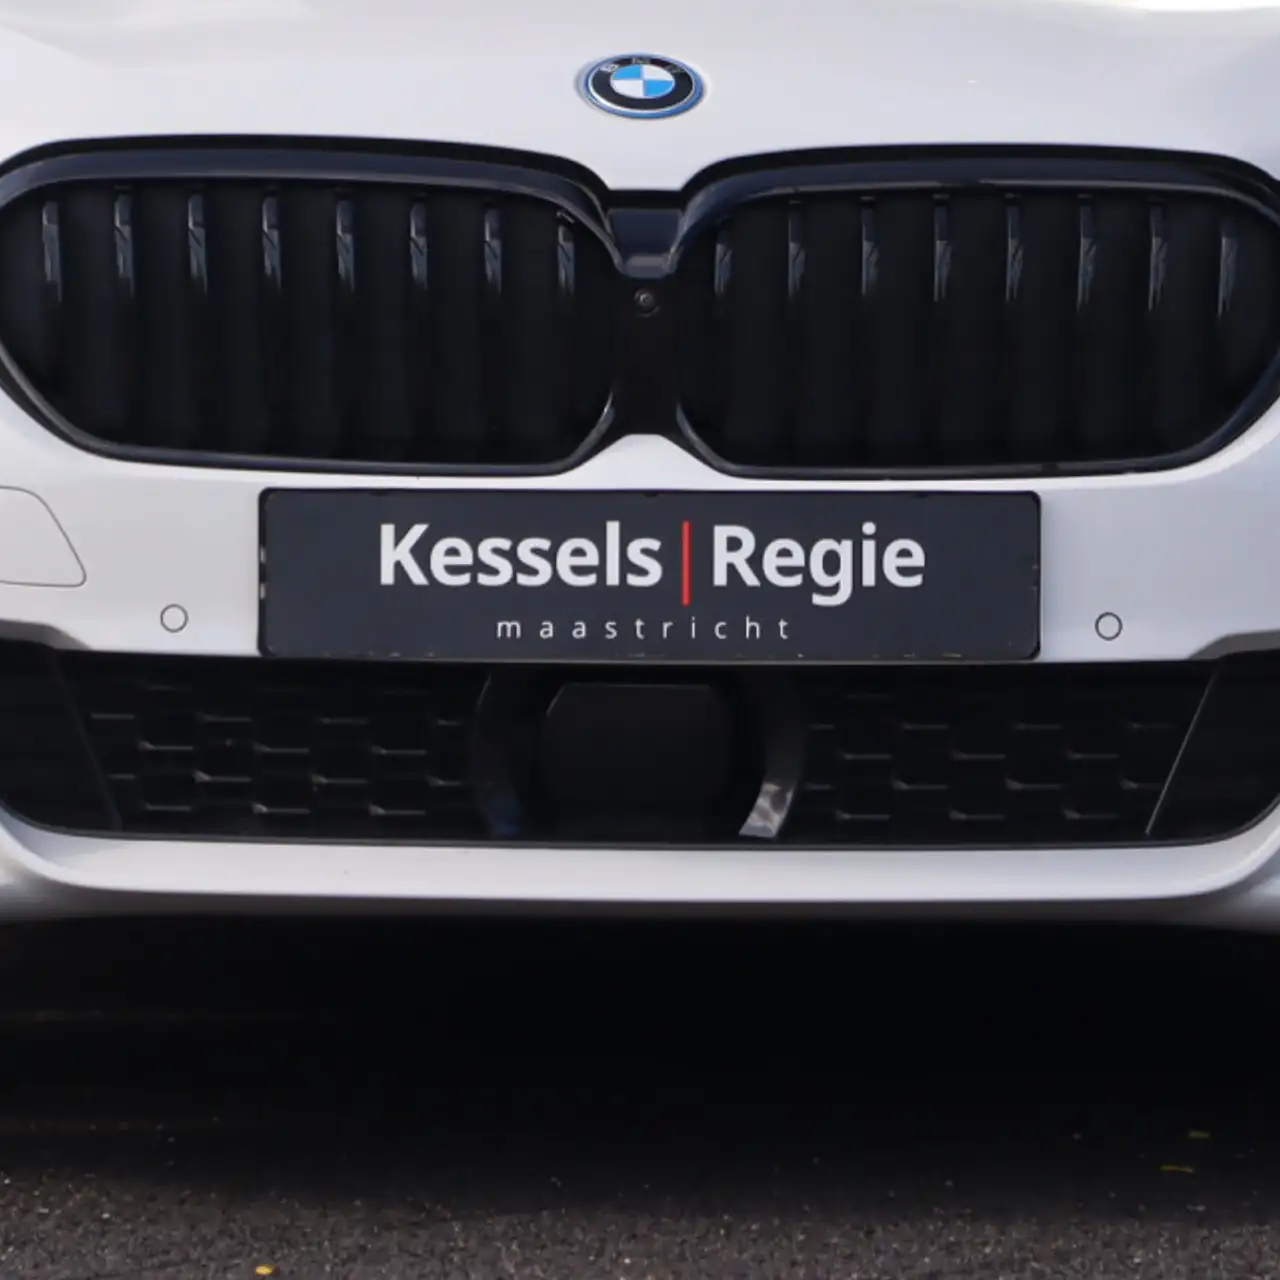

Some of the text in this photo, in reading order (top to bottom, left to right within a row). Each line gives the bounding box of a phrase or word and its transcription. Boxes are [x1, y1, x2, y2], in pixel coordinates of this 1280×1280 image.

[378, 519, 927, 608] Kessels Regie
[495, 615, 790, 641] maastricht
